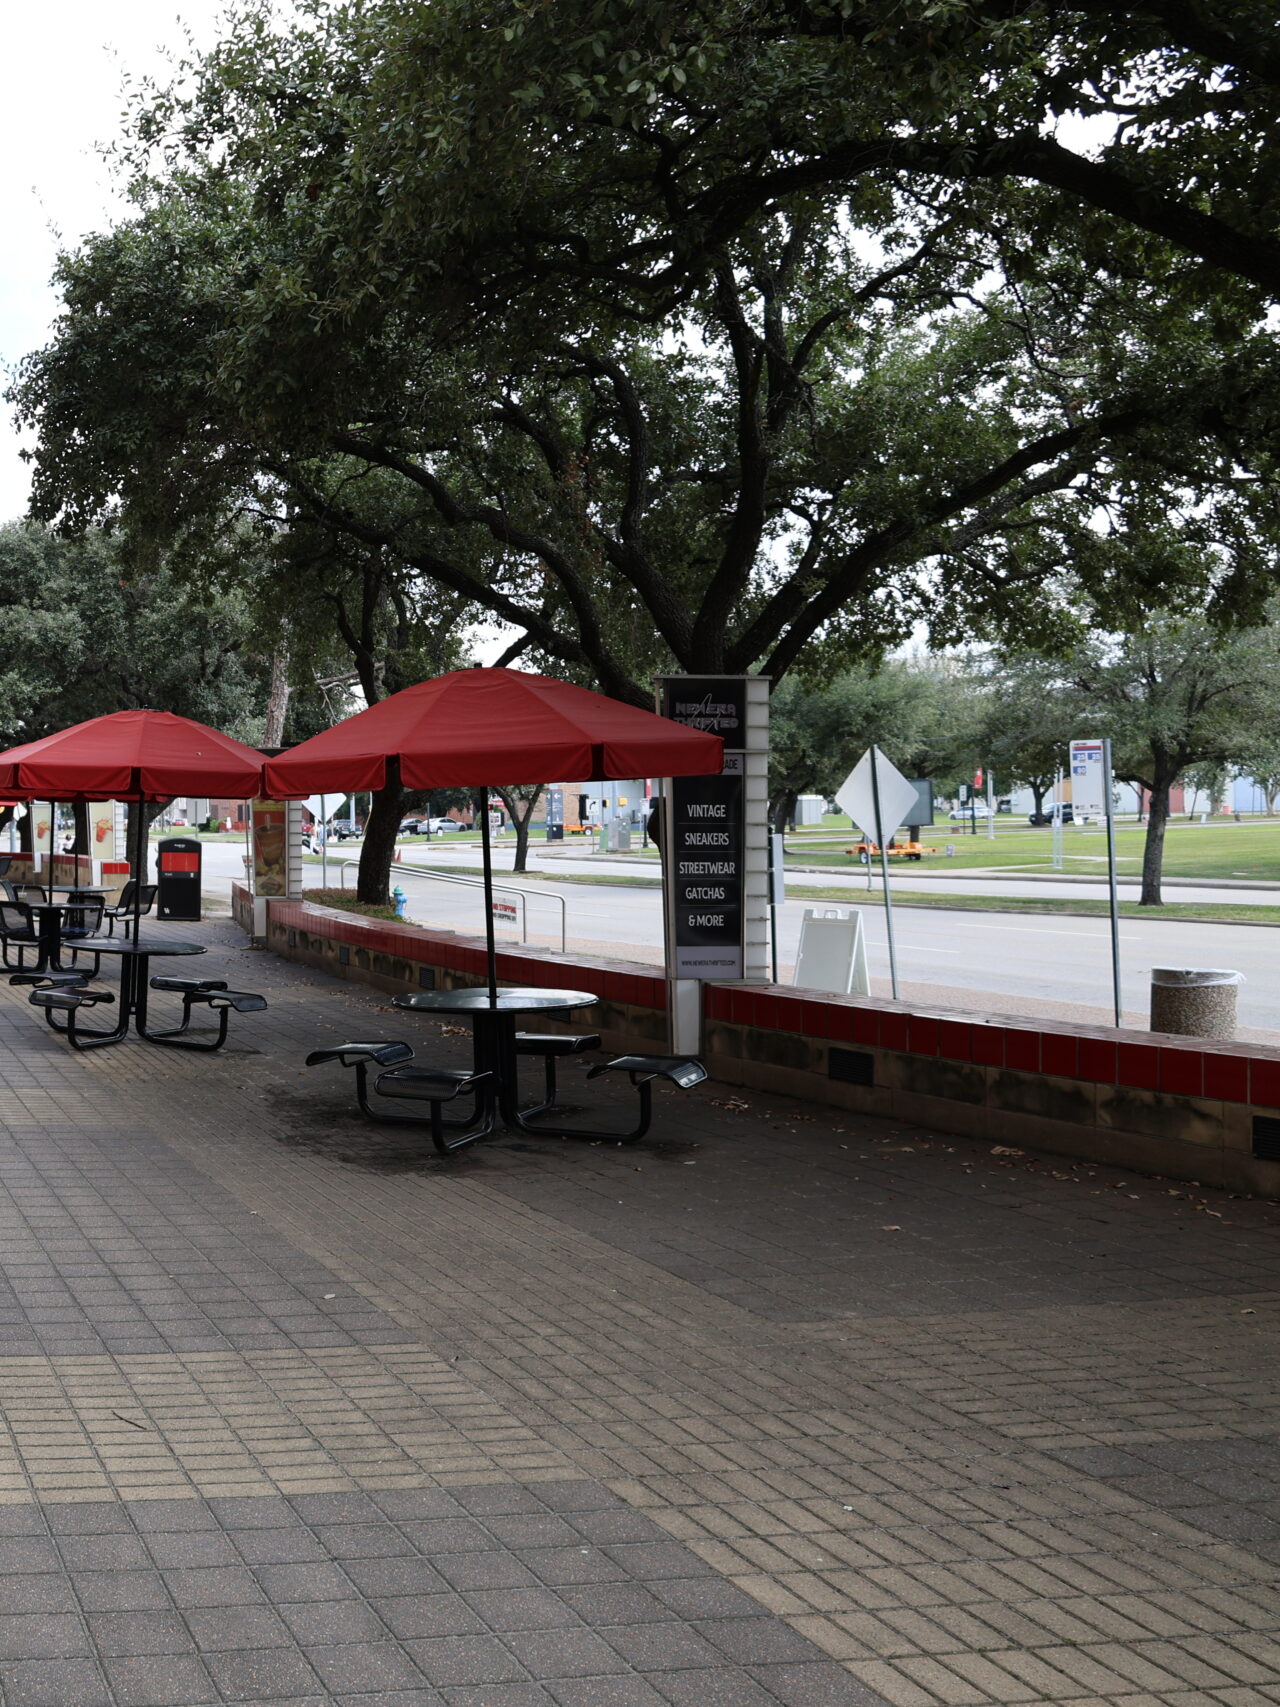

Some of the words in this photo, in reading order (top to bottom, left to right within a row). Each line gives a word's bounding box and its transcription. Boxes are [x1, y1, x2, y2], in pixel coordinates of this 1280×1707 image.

[687, 804, 726, 818] VINTAGE
[684, 832, 730, 846] SNEAKERS
[679, 861, 736, 874] STREETWEAR
[685, 887, 726, 900] GATCHAS
[688, 914, 696, 927] &
[696, 914, 725, 927] MORE
